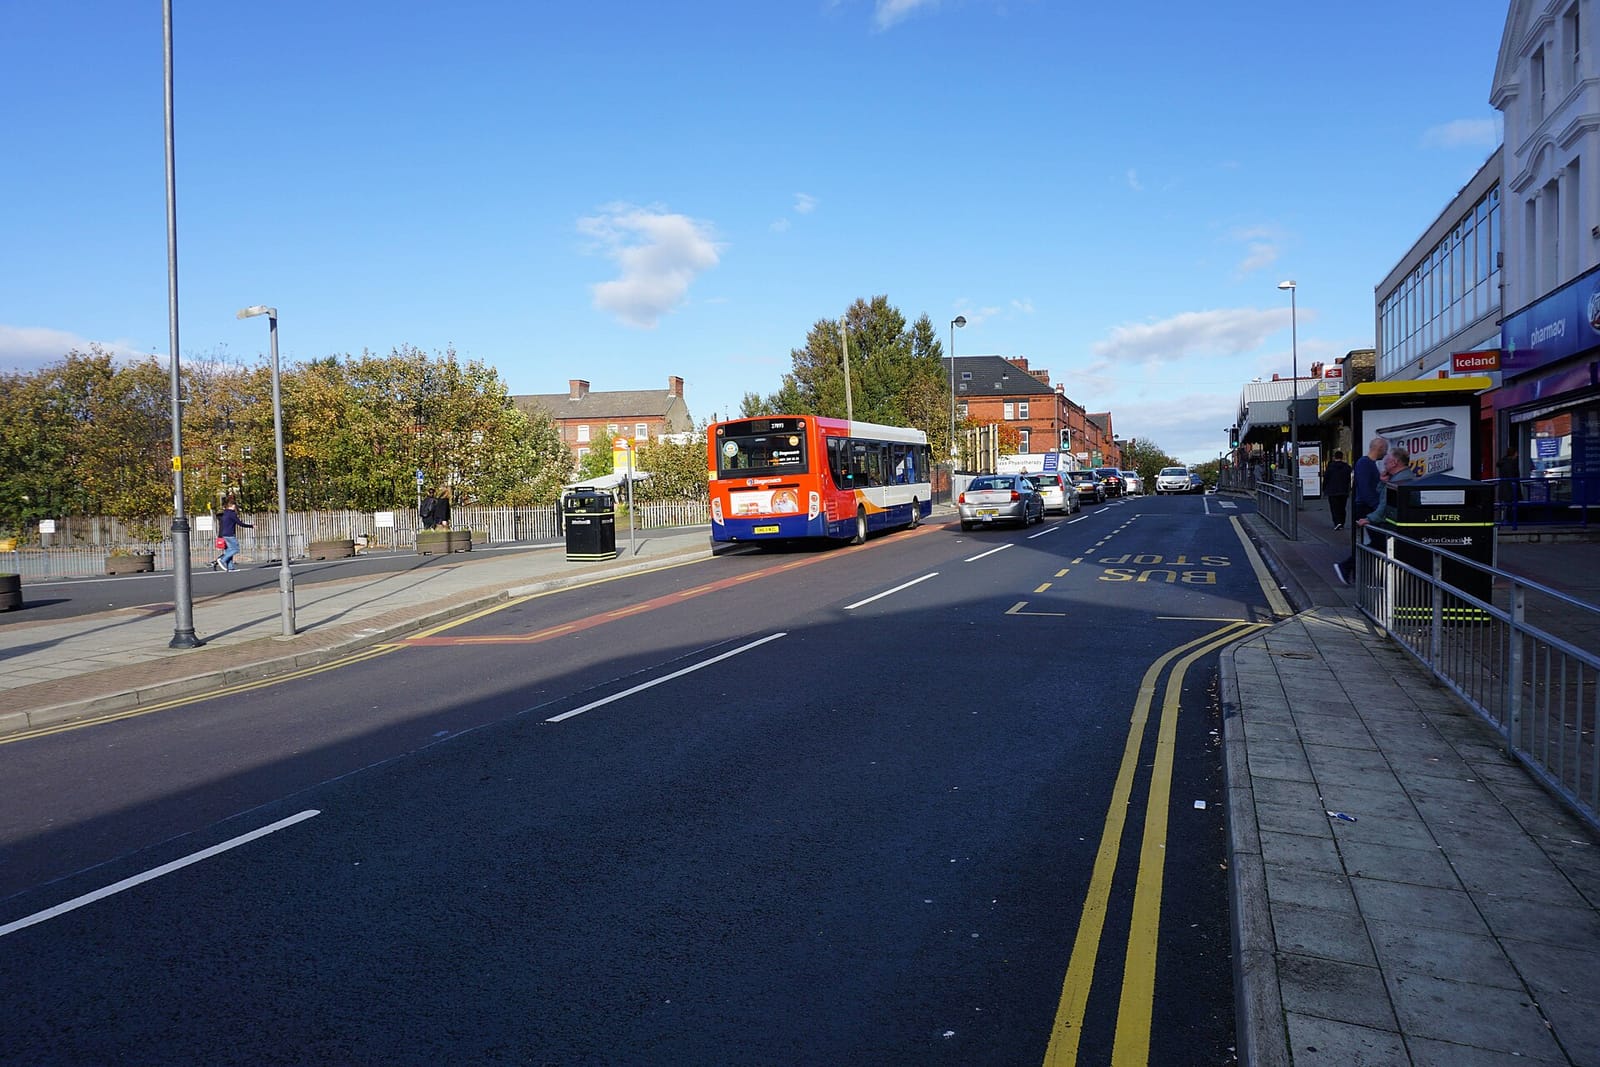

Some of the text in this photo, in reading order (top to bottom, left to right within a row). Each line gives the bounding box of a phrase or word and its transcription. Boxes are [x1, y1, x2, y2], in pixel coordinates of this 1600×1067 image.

[1531, 318, 1567, 347] pharmacy
[1456, 356, 1496, 367] Iceland
[1099, 554, 1231, 567] STOP
[1098, 568, 1218, 585] BUS
